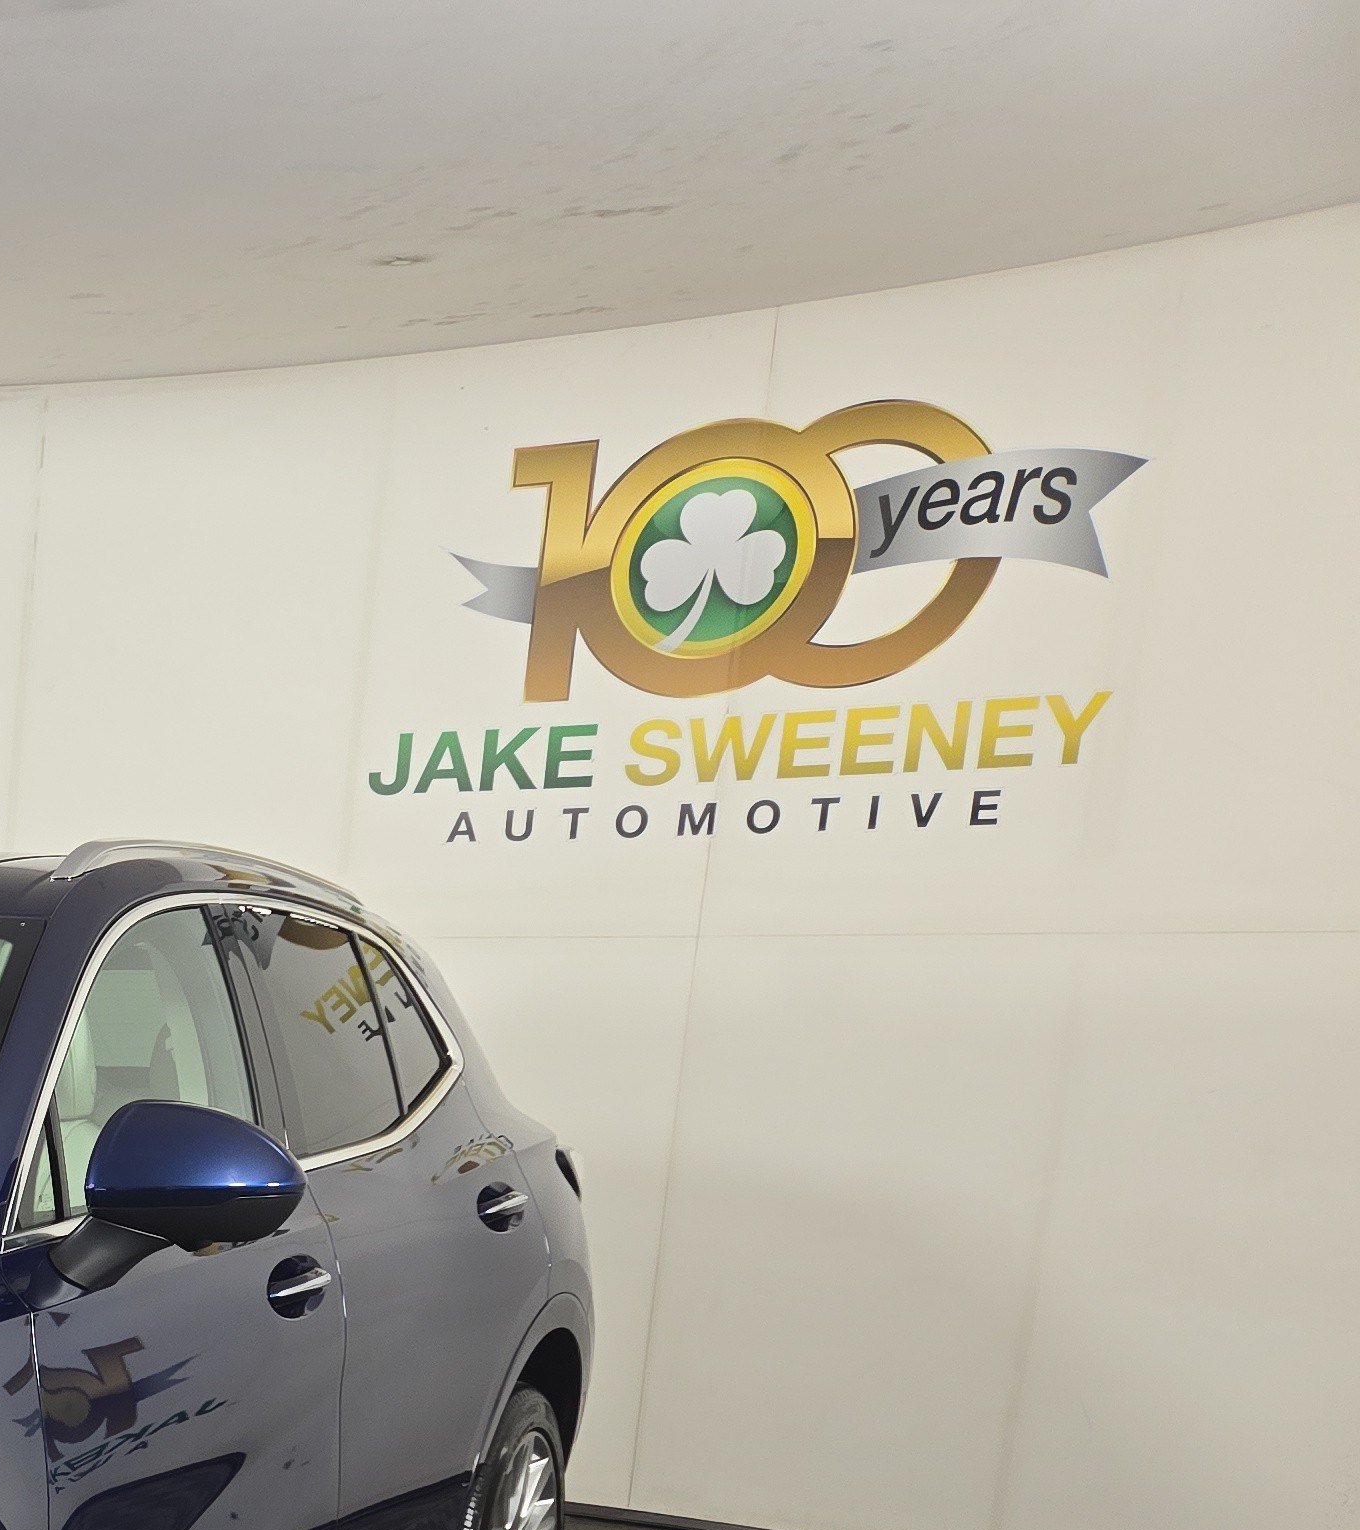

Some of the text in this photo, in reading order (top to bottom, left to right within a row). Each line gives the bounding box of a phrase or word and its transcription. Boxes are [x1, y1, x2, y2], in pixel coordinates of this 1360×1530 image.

[513, 398, 1001, 703] 100
[870, 464, 1078, 558] years
[368, 690, 1113, 796] JAKE SWEENEY
[446, 790, 1003, 844] AUTOMOTIVE
